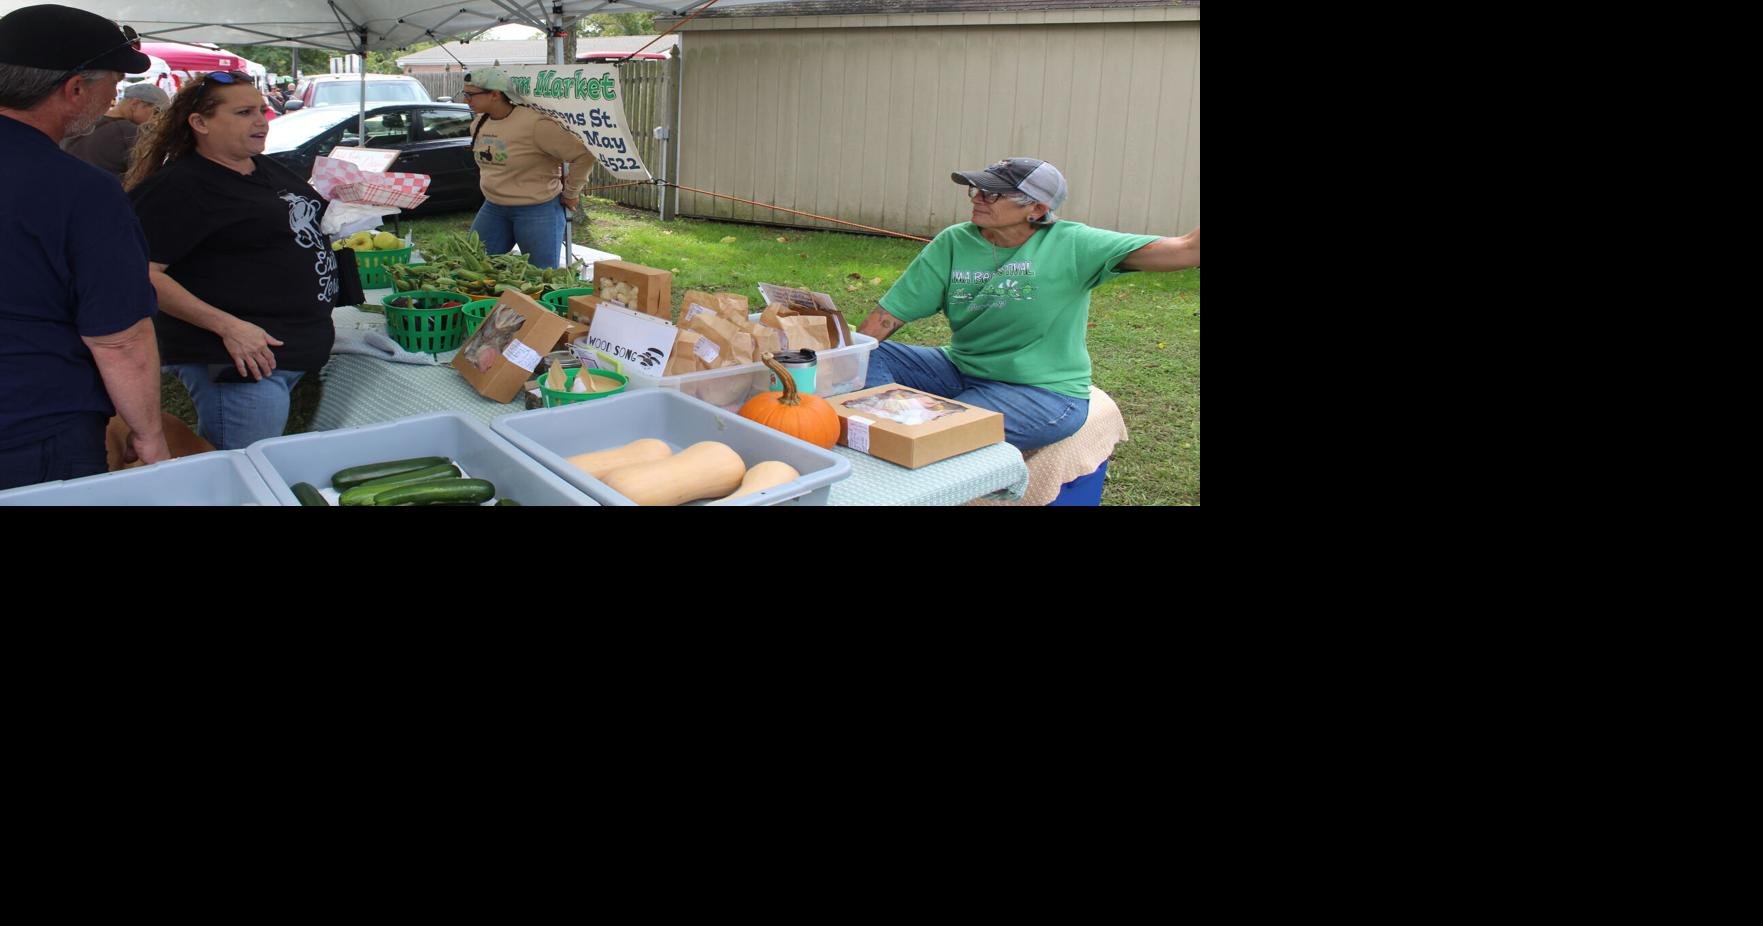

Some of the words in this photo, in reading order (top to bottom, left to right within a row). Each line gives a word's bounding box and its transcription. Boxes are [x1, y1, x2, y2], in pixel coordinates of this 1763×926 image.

[533, 69, 617, 101] Market
[589, 107, 617, 128] St.
[583, 130, 626, 153] May
[589, 336, 611, 352] WOOD
[613, 346, 637, 361] SONG
